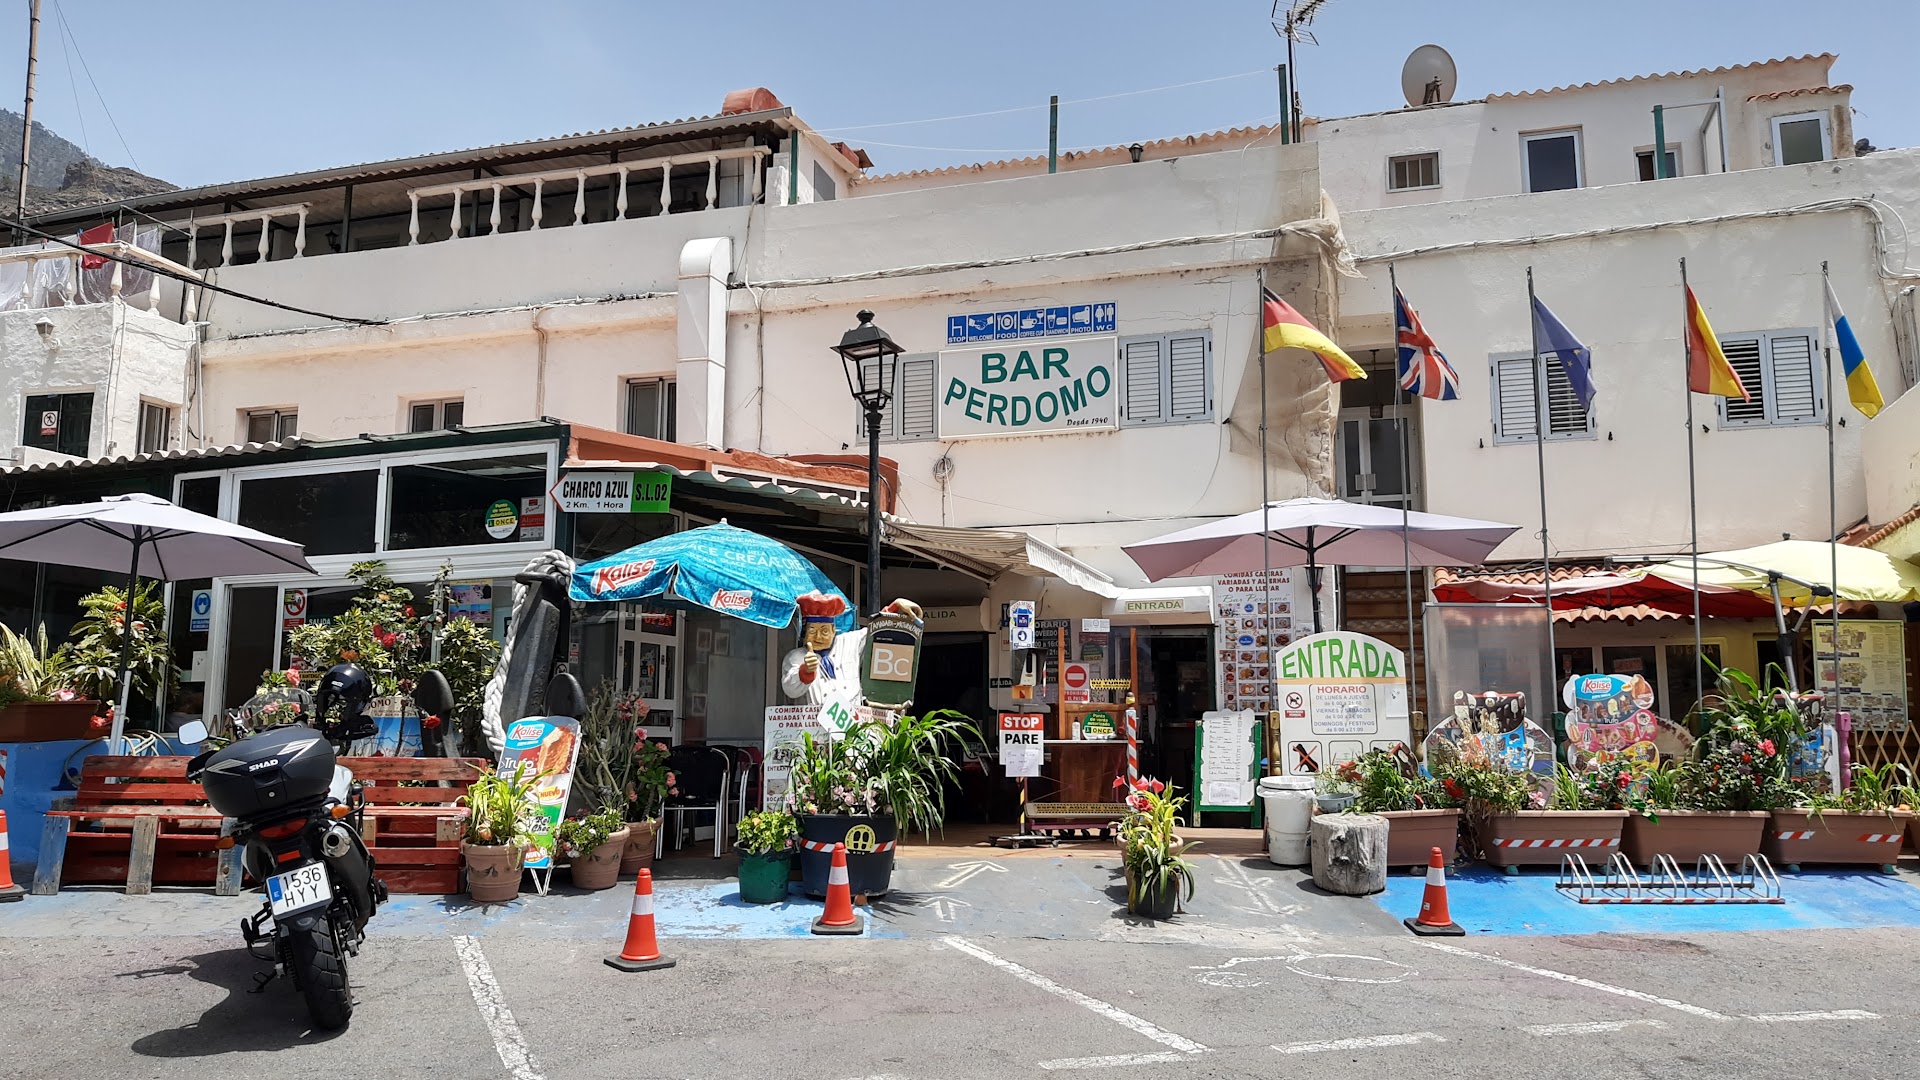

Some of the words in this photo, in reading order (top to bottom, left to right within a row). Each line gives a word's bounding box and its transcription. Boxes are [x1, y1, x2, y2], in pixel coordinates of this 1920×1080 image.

[996, 332, 1017, 340] FOOD
[1046, 328, 1068, 336] SANDWICH
[1070, 326, 1092, 334] PHOTO
[968, 334, 994, 342] WELCOME
[982, 348, 1070, 384] BAR
[944, 365, 1111, 426] PERDOMO
[1066, 418, 1089, 426] Desde
[1092, 416, 1108, 424] 1940
[562, 480, 601, 499] CHARCO
[604, 480, 629, 498] AZUL
[636, 484, 668, 502] S.L.02
[496, 518, 515, 526] ONCE
[596, 560, 656, 594] Kalise
[714, 588, 751, 608] Kalise
[1127, 601, 1182, 610] ENTRADA
[922, 610, 957, 619] ALIDA
[308, 618, 331, 626] SALIDA
[1035, 620, 1068, 628] ORARIO
[1282, 638, 1399, 678] ENTRADA
[1317, 686, 1367, 694] HORARIO
[1584, 679, 1612, 692] Kalise
[1004, 716, 1040, 728] STOP
[512, 724, 542, 740] Kalise
[1005, 734, 1038, 745] PARE
[249, 759, 278, 772] SHAD
[540, 786, 560, 798] NUEVO
[282, 867, 322, 891] 1536
[284, 884, 320, 908] HYY
